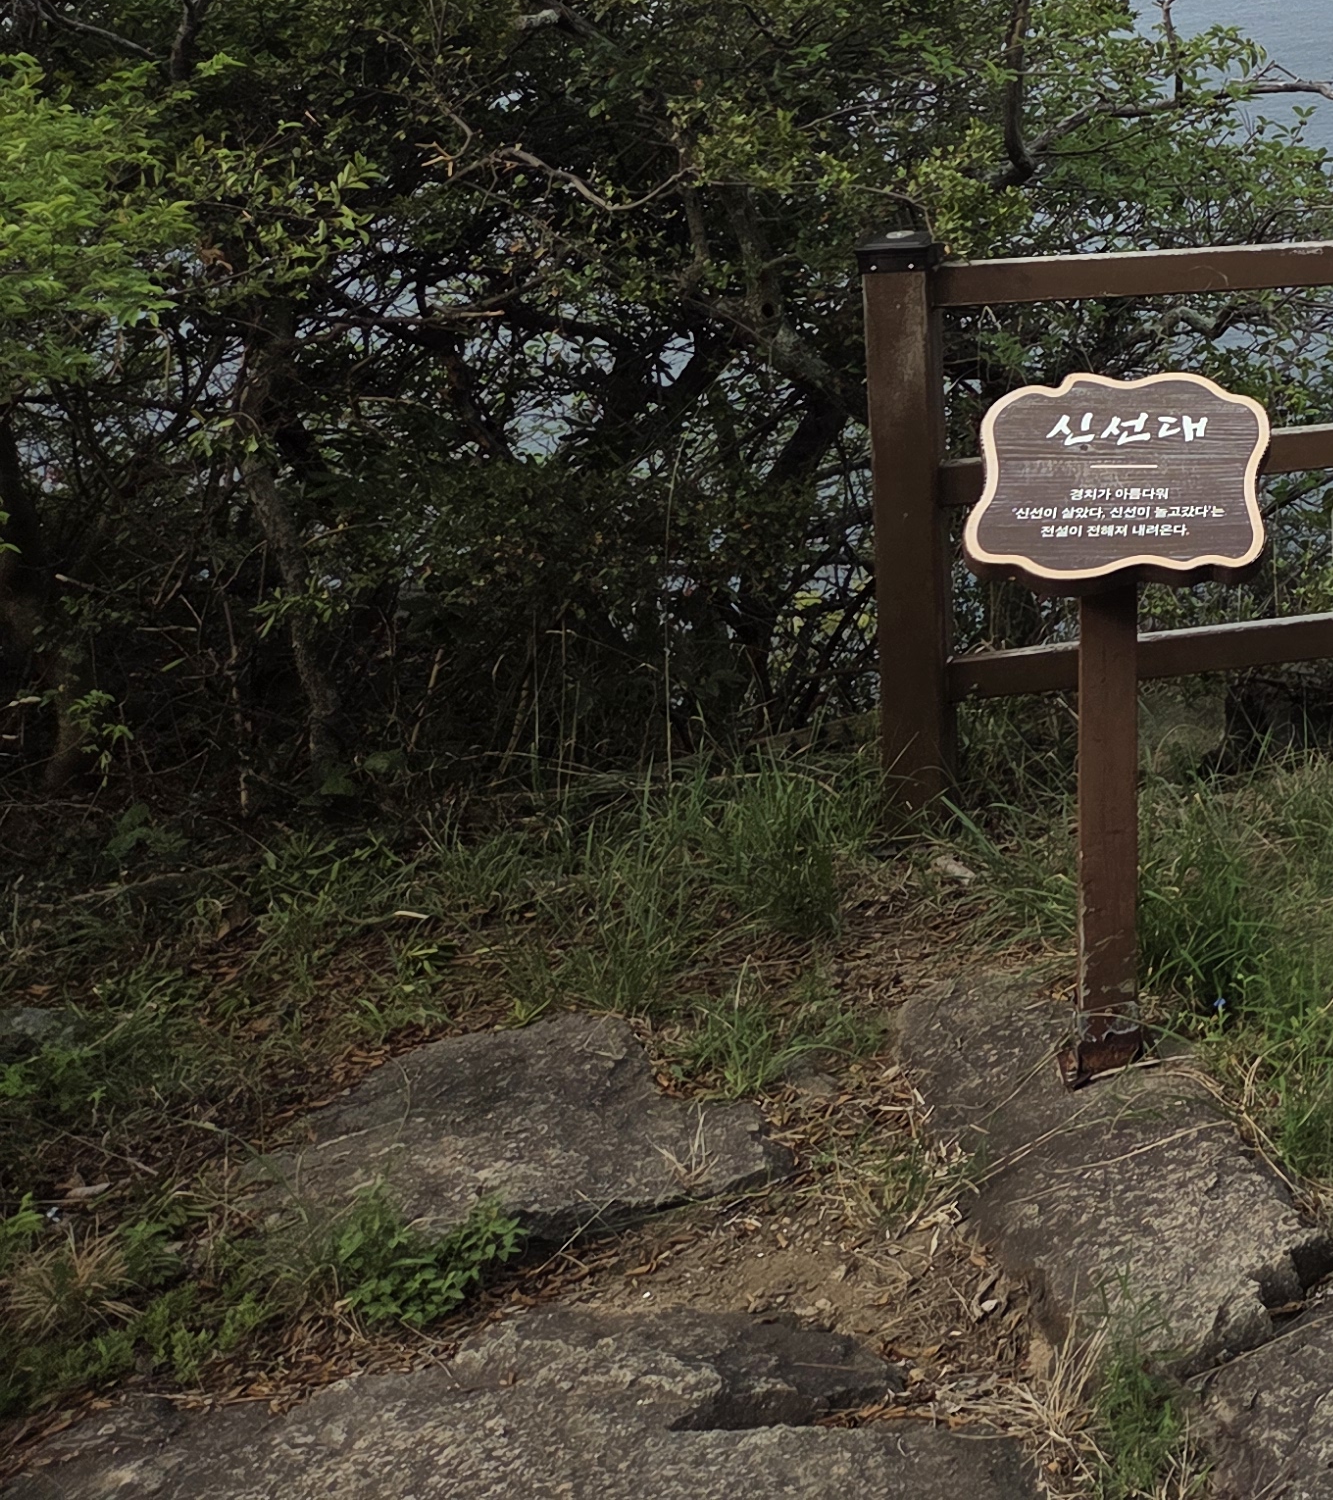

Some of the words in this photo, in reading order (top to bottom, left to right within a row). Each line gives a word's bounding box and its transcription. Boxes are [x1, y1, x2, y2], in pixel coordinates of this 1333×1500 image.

[1046, 411, 1208, 447] 신선대
[1069, 488, 1111, 500] 경치가
[1115, 488, 1169, 500] 아름다워
[1062, 507, 1105, 519] 살았다,
[1110, 506, 1150, 518] 신선이
[1041, 525, 1083, 538] 전설이
[1087, 525, 1128, 537] 전해져
[1132, 524, 1190, 537] 내려온다.
